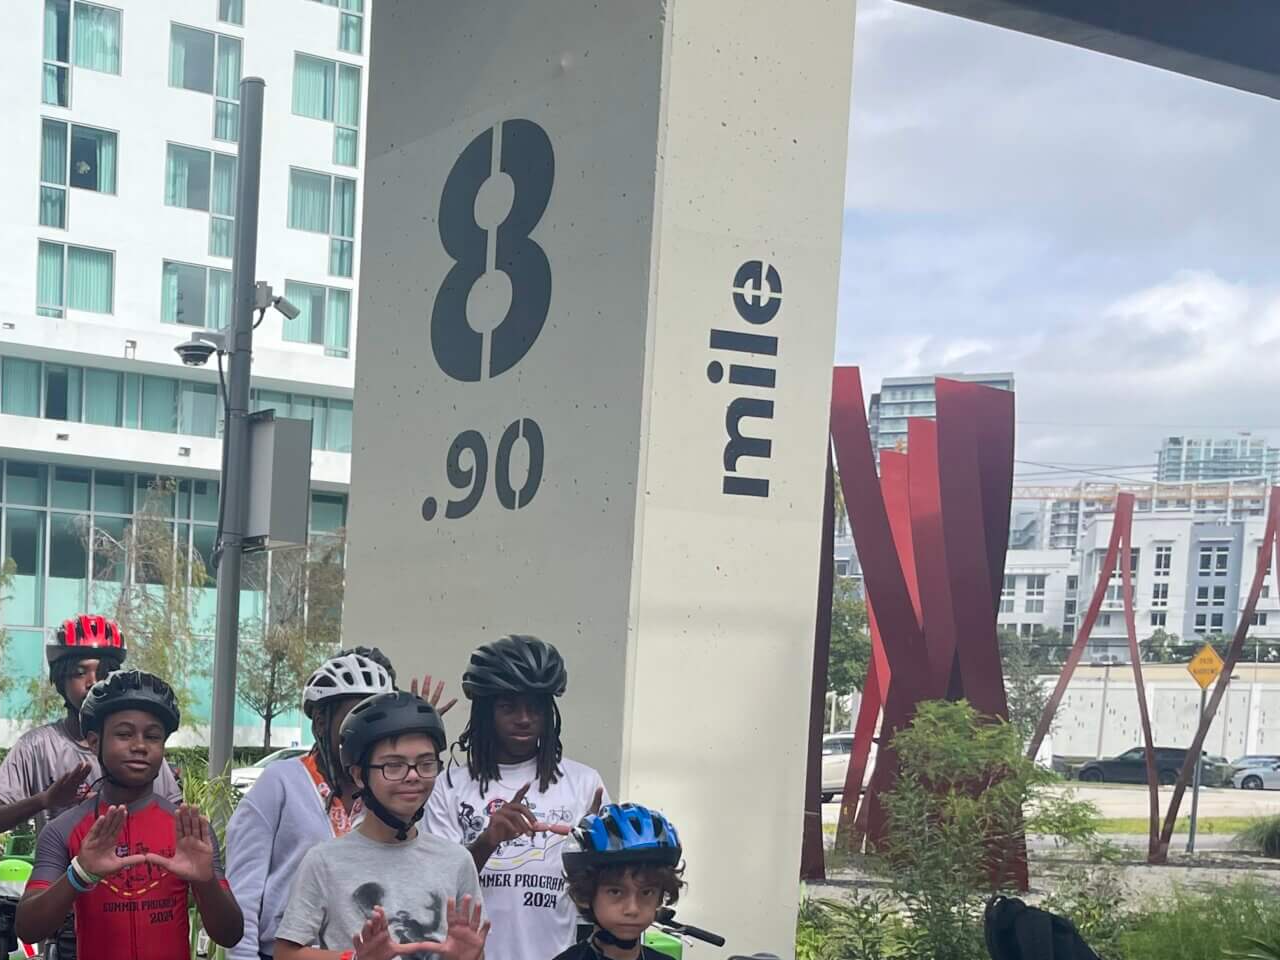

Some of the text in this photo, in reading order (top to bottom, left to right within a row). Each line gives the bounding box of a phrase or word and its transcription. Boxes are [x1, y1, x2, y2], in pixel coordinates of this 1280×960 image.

[431, 118, 555, 382] 8
[707, 260, 782, 497] mile
[422, 418, 544, 521] .90
[479, 874, 511, 888] MMER
[523, 892, 557, 909] 2024
